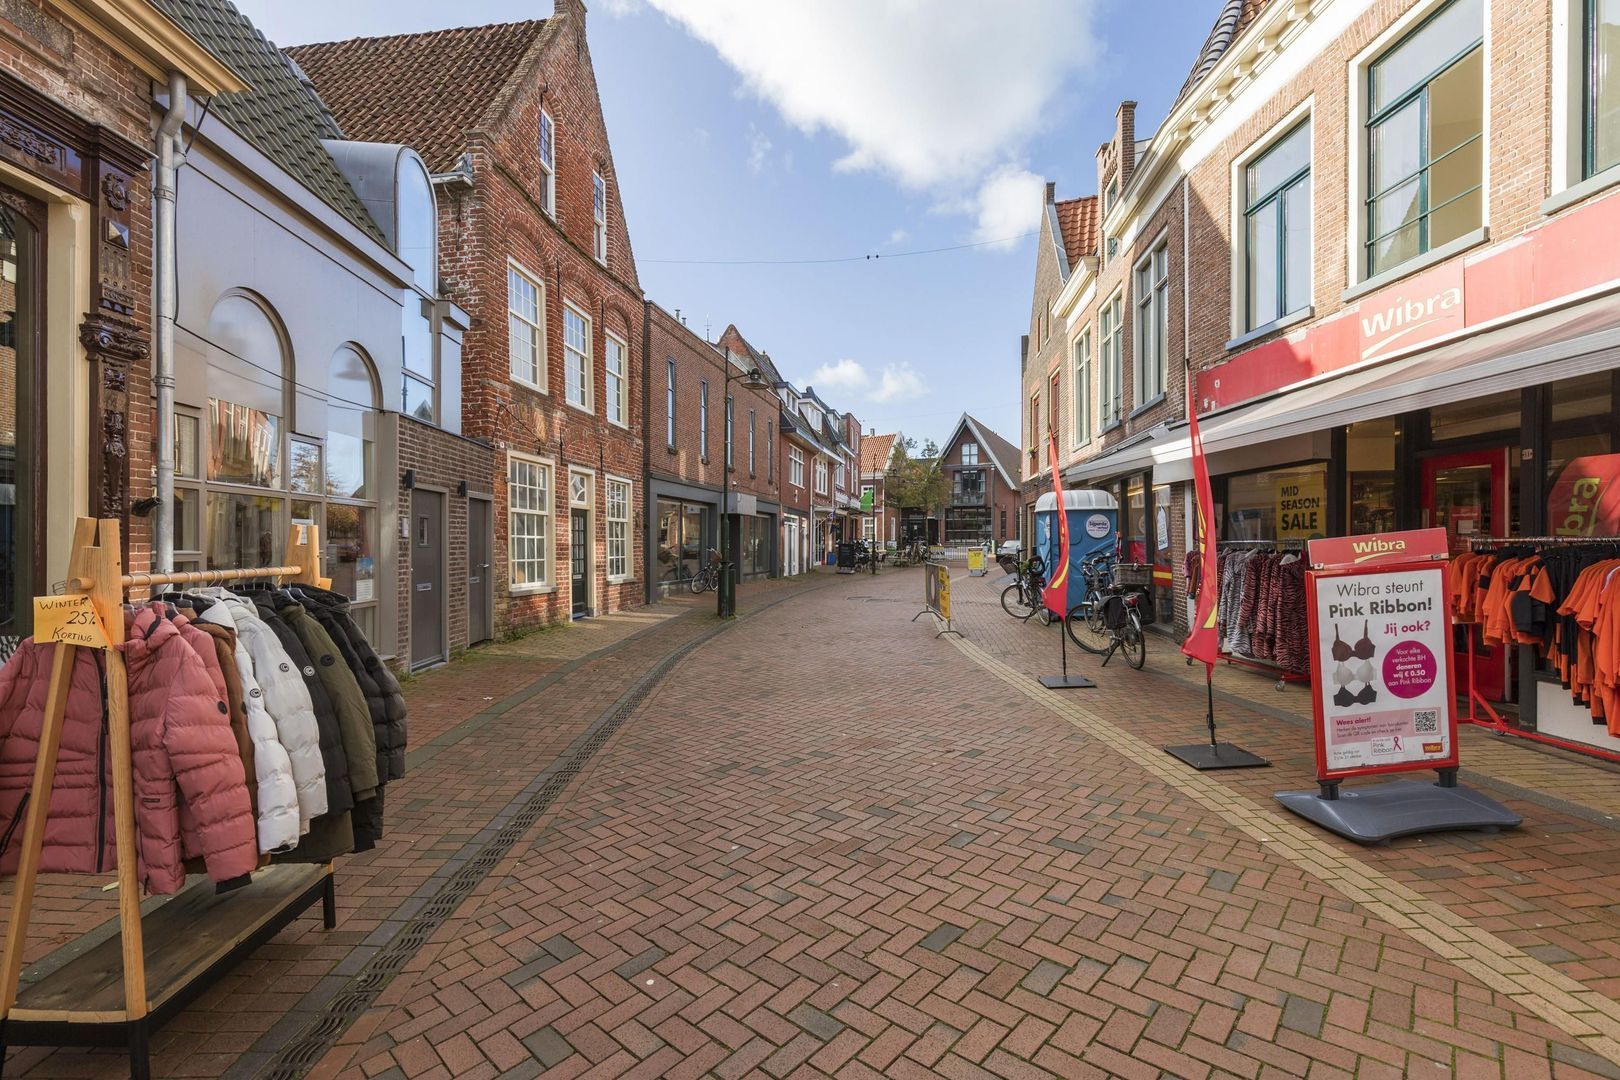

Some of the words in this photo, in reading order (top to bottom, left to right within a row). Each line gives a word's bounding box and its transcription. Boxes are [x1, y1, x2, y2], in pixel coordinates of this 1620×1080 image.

[1362, 287, 1461, 338] Wibra
[1281, 485, 1299, 497] MID
[1280, 497, 1320, 511] SEASON
[1281, 512, 1317, 531] SALE
[1352, 537, 1406, 553] Wibra
[1336, 582, 1380, 598] Wibra
[1385, 580, 1424, 594] steunt
[1329, 602, 1364, 619] Pink
[1370, 598, 1432, 615] Ribbon!
[66, 611, 96, 625] 25%
[1383, 623, 1398, 637] Jij
[1401, 621, 1431, 632] ook?
[1392, 655, 1415, 663] verkochte
[1396, 662, 1422, 670] doneren
[1399, 678, 1412, 686] Pink
[1413, 677, 1432, 685] Ribbon
[1336, 718, 1353, 726] Wees
[1355, 716, 1371, 724] alert!
